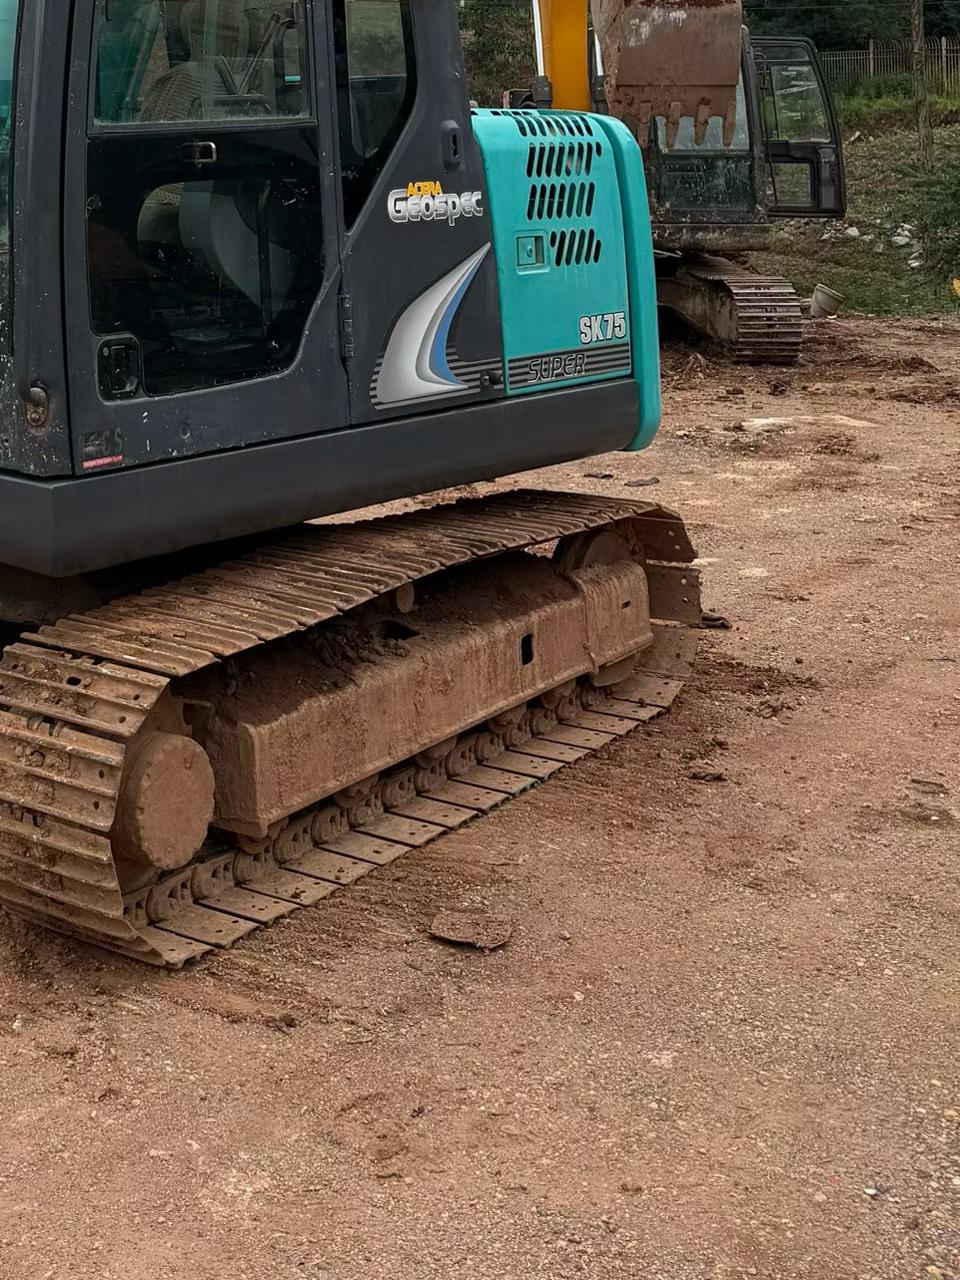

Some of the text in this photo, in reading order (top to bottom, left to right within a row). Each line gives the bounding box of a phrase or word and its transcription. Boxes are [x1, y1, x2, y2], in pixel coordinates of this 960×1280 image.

[406, 181, 443, 197] ACERA
[579, 312, 627, 344] SK75
[528, 353, 588, 383] SUPER
